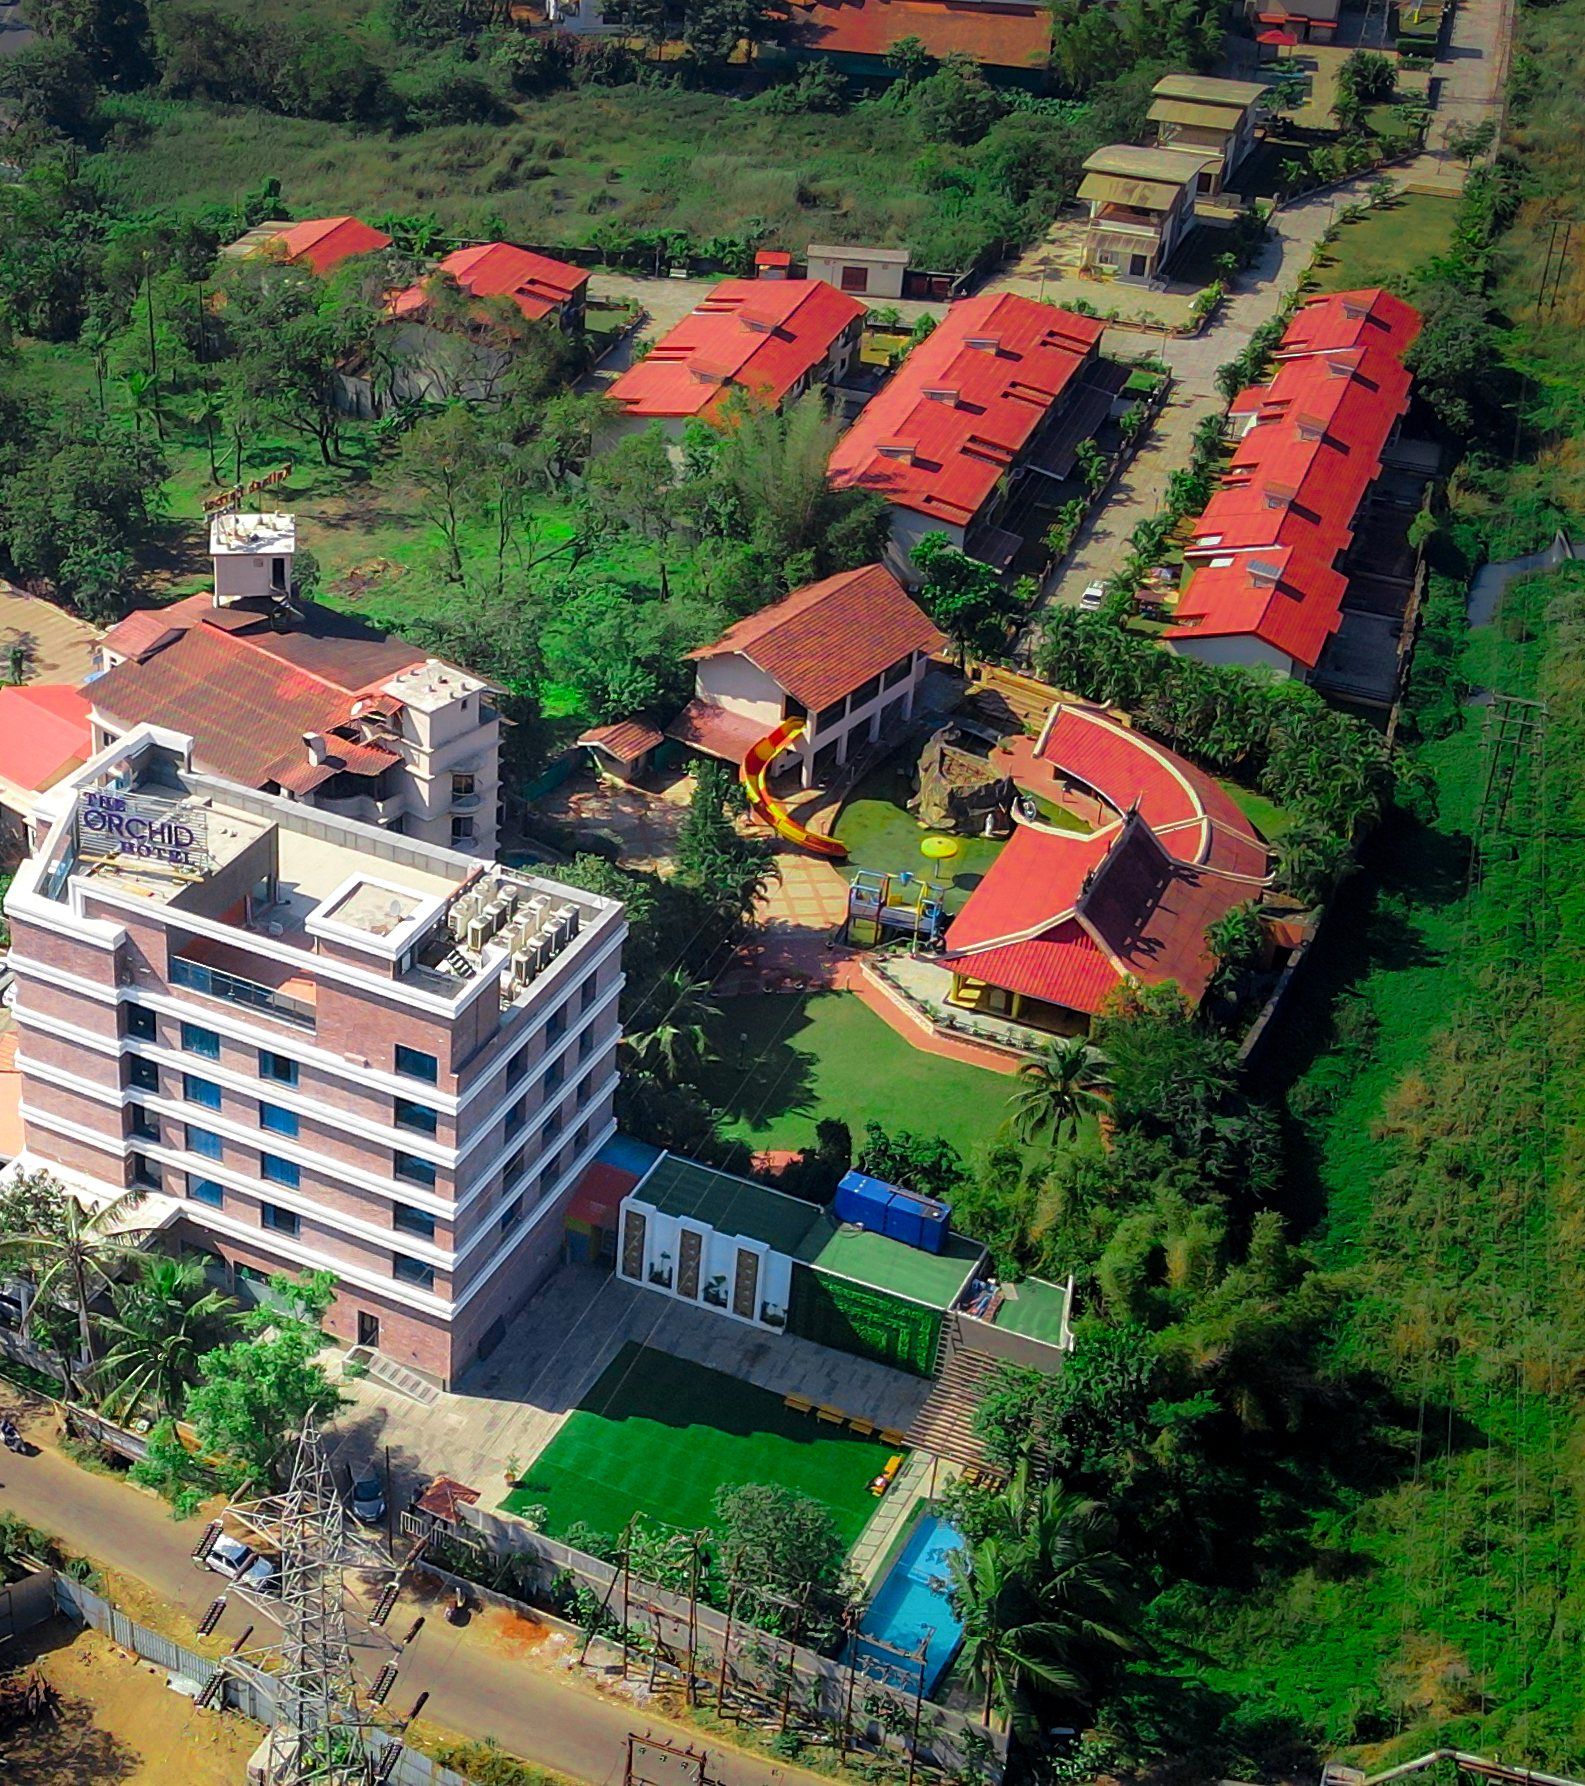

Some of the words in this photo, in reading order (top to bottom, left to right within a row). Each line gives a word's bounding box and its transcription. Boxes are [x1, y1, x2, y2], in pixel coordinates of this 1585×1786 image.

[83, 792, 126, 812] THE
[84, 809, 194, 847] ORCHID
[120, 841, 196, 865] HOTEL
